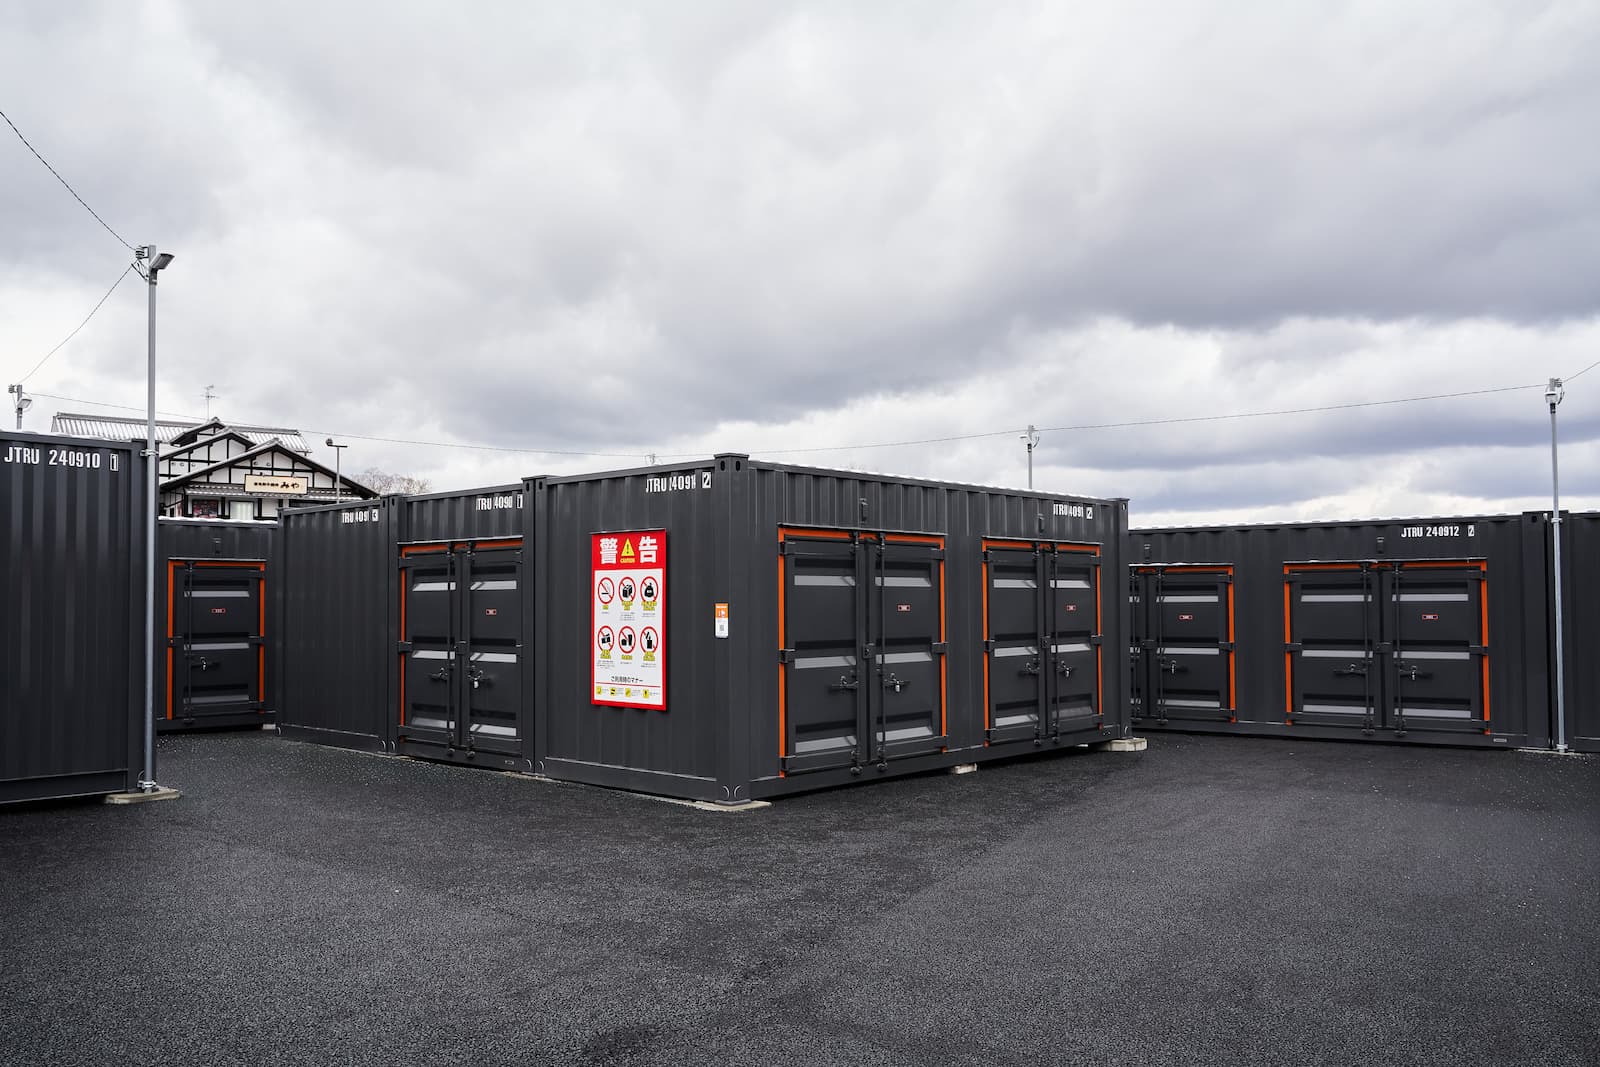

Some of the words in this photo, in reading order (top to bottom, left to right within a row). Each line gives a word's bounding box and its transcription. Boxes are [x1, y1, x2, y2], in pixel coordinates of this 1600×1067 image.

[4, 446, 40, 465] JTRU
[48, 449, 101, 469] 240910
[109, 453, 119, 471] 1
[702, 471, 712, 489] 2
[1086, 506, 1093, 520] 2
[1400, 526, 1423, 538] JTRU
[1426, 525, 1460, 537] 240912
